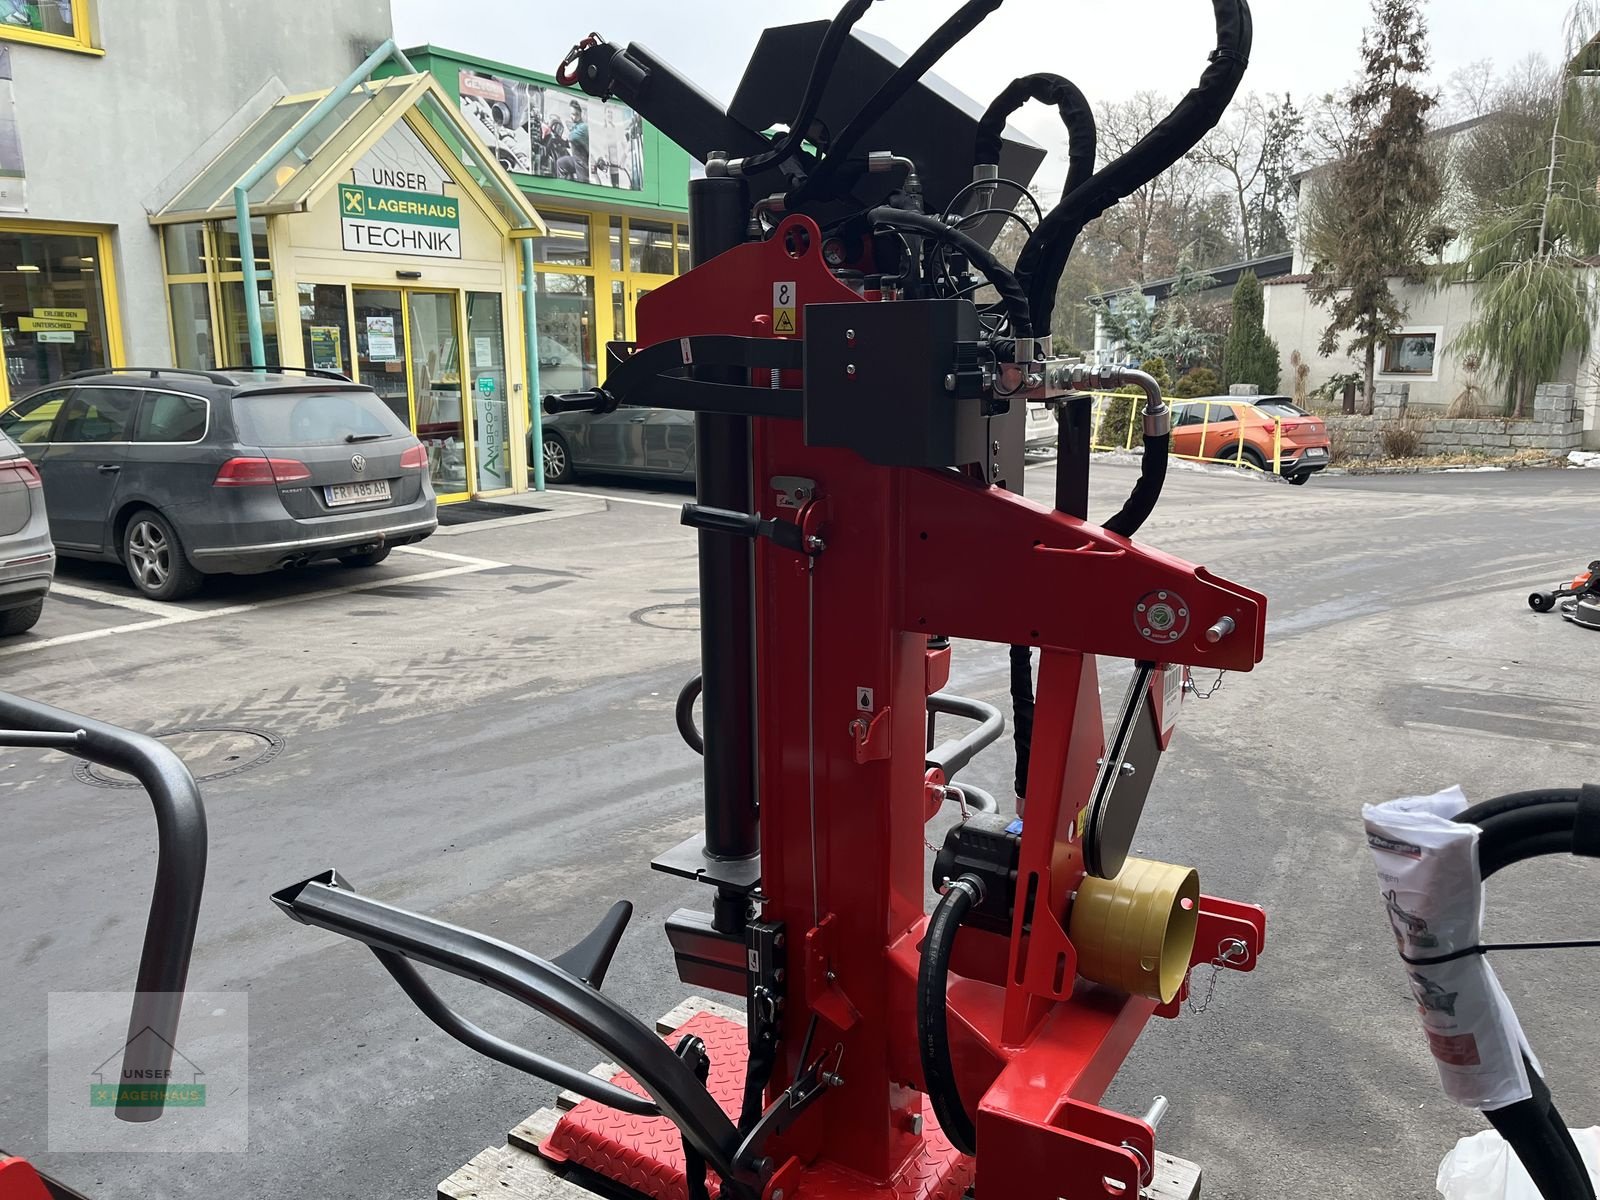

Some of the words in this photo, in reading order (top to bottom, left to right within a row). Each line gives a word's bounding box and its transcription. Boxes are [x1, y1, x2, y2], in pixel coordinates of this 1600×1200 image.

[372, 168, 427, 191] UNSER
[367, 197, 457, 218] LAGERHAUS
[349, 224, 452, 251] TECHNIK
[333, 486, 346, 500] FR
[353, 484, 372, 497] 485
[374, 481, 387, 495] AH
